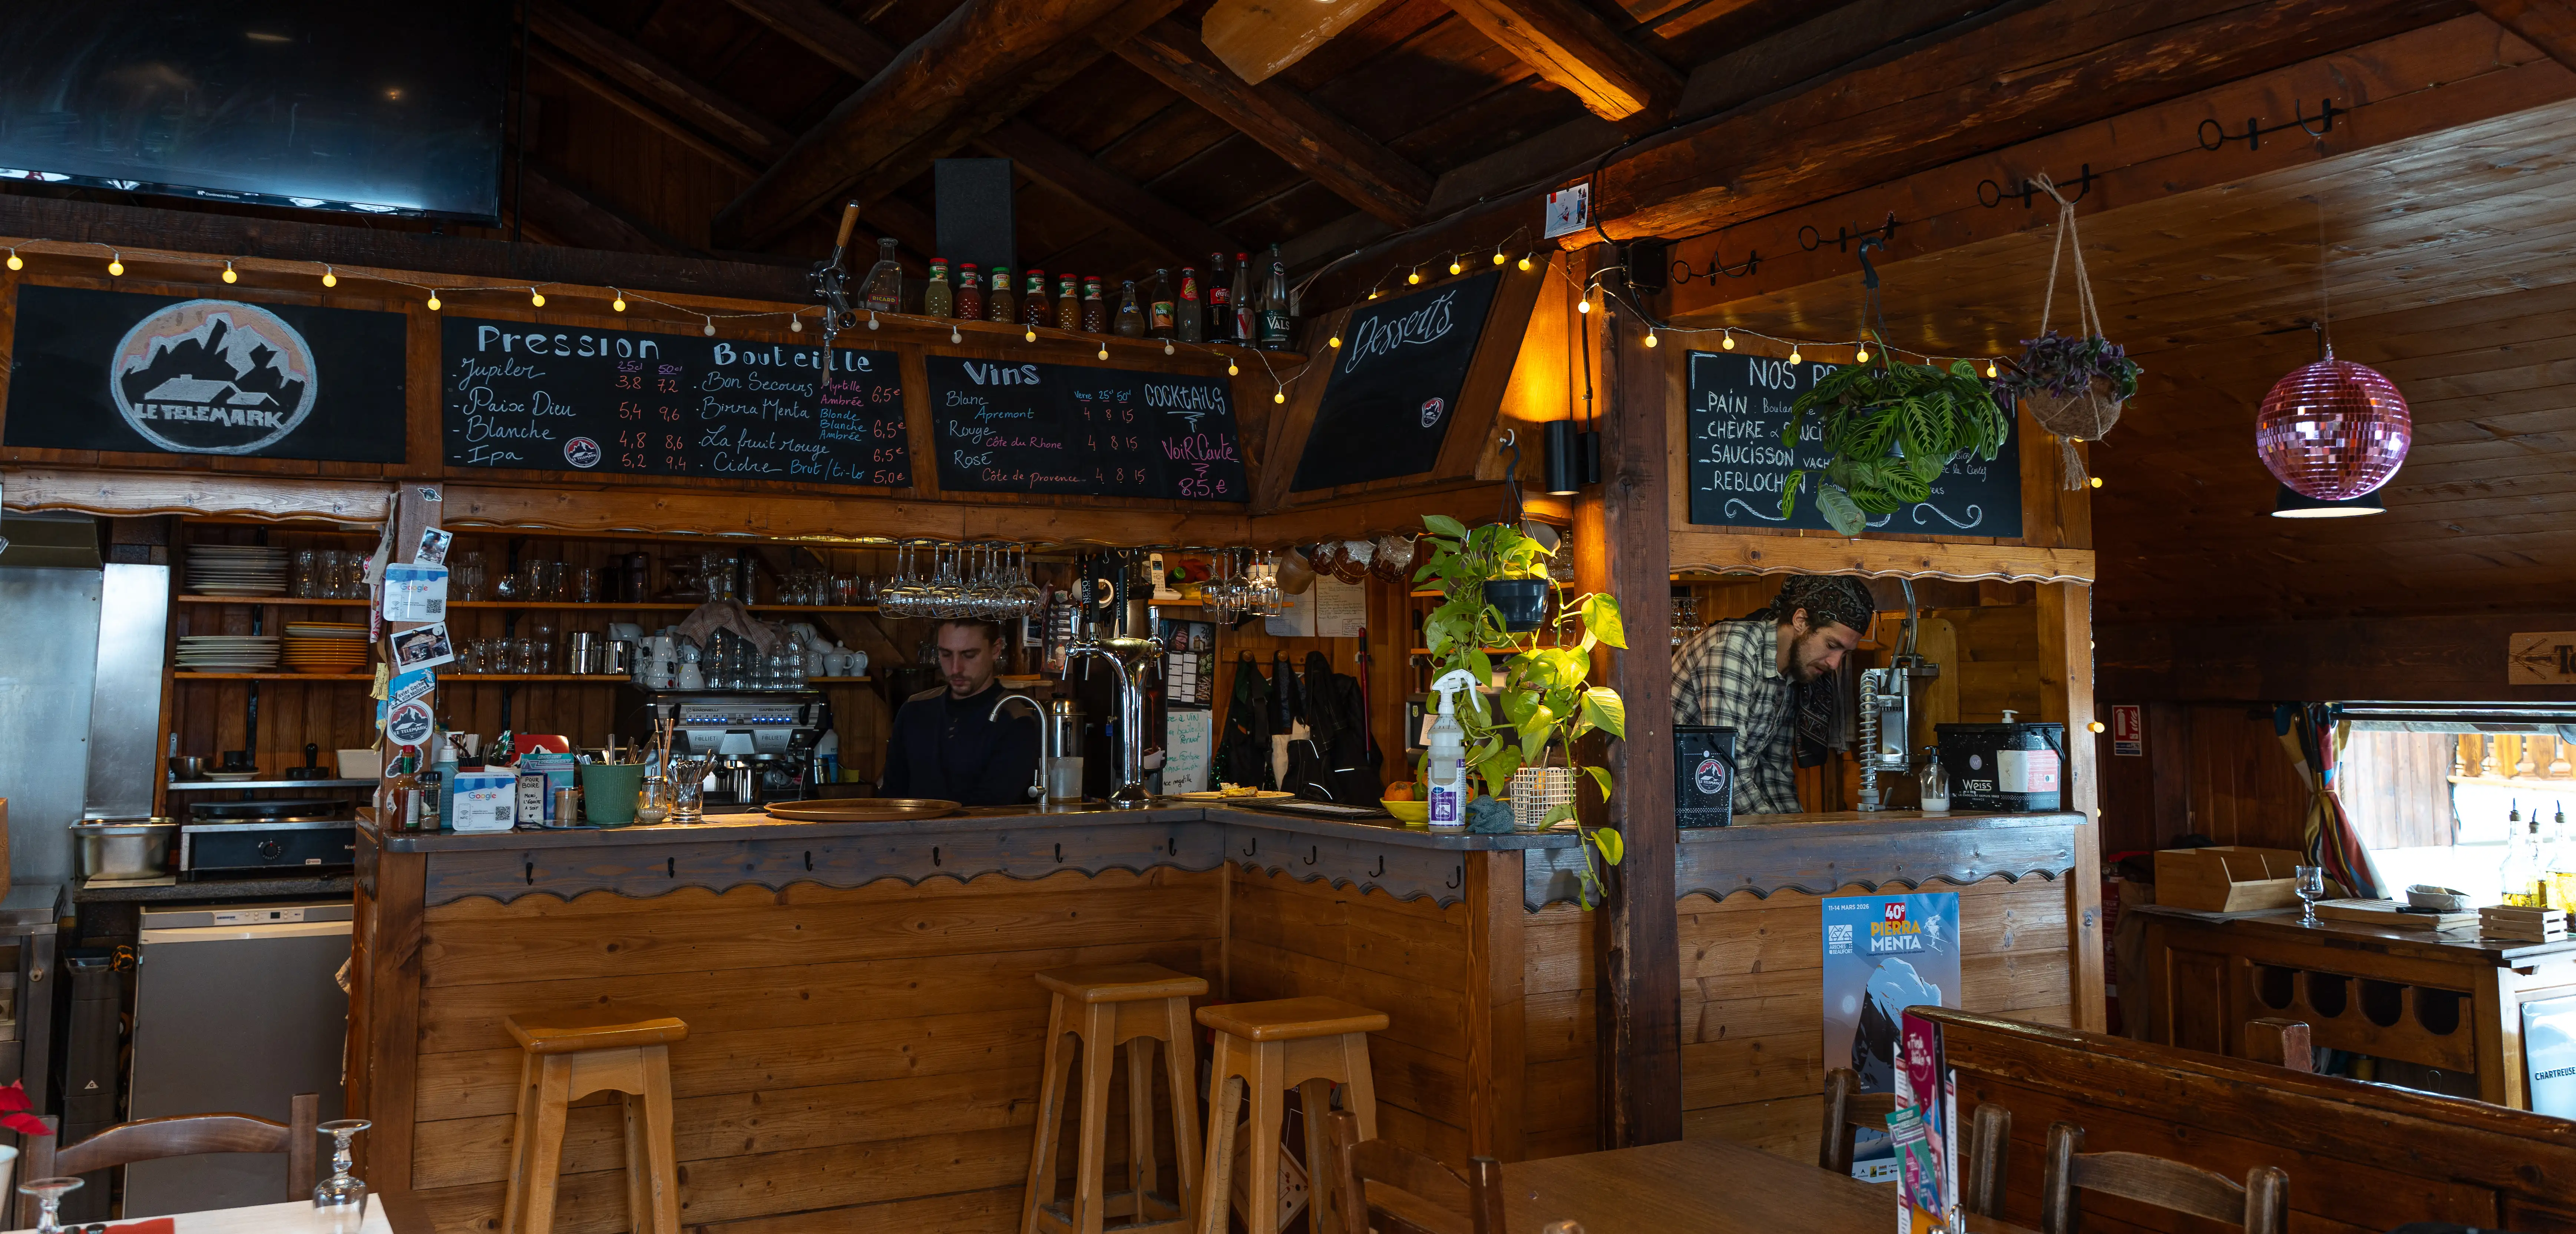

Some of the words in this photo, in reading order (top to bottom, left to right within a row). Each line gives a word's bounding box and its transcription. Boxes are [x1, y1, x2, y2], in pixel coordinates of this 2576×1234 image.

[1267, 316, 1290, 330] VALS
[1346, 290, 1456, 374] Desserts
[479, 326, 658, 359] Pression
[714, 343, 873, 371] Bouteille
[459, 358, 545, 390] Jupiler
[616, 375, 641, 390] 3,8
[658, 378, 678, 393] 7,2
[963, 361, 1041, 385] Vins
[1750, 358, 1796, 389] NOS
[702, 372, 742, 391] Bon
[749, 372, 813, 397] Secours
[463, 387, 524, 415] Paix
[532, 391, 576, 416] Dieu
[620, 401, 641, 420] 5,4
[659, 407, 679, 421] 9,6
[947, 391, 989, 407] Blanc
[134, 403, 157, 419] LE
[161, 404, 284, 428] TELEMARK
[763, 398, 810, 421] Menta
[820, 409, 860, 420] Blonde
[975, 407, 1034, 420] Apremont
[1084, 409, 1090, 419] 4
[1106, 409, 1111, 419] 8
[1122, 409, 1134, 422] 15
[466, 415, 556, 442] Blanche
[620, 430, 646, 449] 4,8
[666, 435, 683, 450] 8,6
[820, 419, 867, 432] Blanche
[949, 421, 996, 444] Rouge
[1708, 416, 1764, 438] CHÈVRE
[701, 425, 731, 447] La
[738, 428, 775, 454] fruit
[779, 439, 830, 461] rouge
[986, 437, 1008, 448] Côte
[1011, 438, 1025, 447] du
[1088, 437, 1095, 449] 4
[1111, 437, 1118, 449] 8
[1126, 437, 1137, 449] 15
[467, 445, 523, 466] Ipa
[622, 454, 646, 468] 5,2
[666, 455, 686, 471] 9,4
[714, 452, 782, 471] Cidre
[954, 450, 992, 468] Rosé
[983, 468, 1008, 481] Côte
[1012, 470, 1024, 480] de
[1030, 471, 1083, 488] provence
[1096, 469, 1103, 482] 4
[1117, 468, 1124, 481] 8
[1135, 468, 1145, 482] 15
[400, 583, 428, 592] Google
[401, 725, 427, 734] TELEMARK
[1962, 779, 1992, 791] Weiss
[469, 792, 496, 800] Google
[1871, 920, 1921, 936] PIERRA
[1871, 935, 1922, 951] MENTA
[2535, 1067, 2576, 1081] CHARTREUSE
